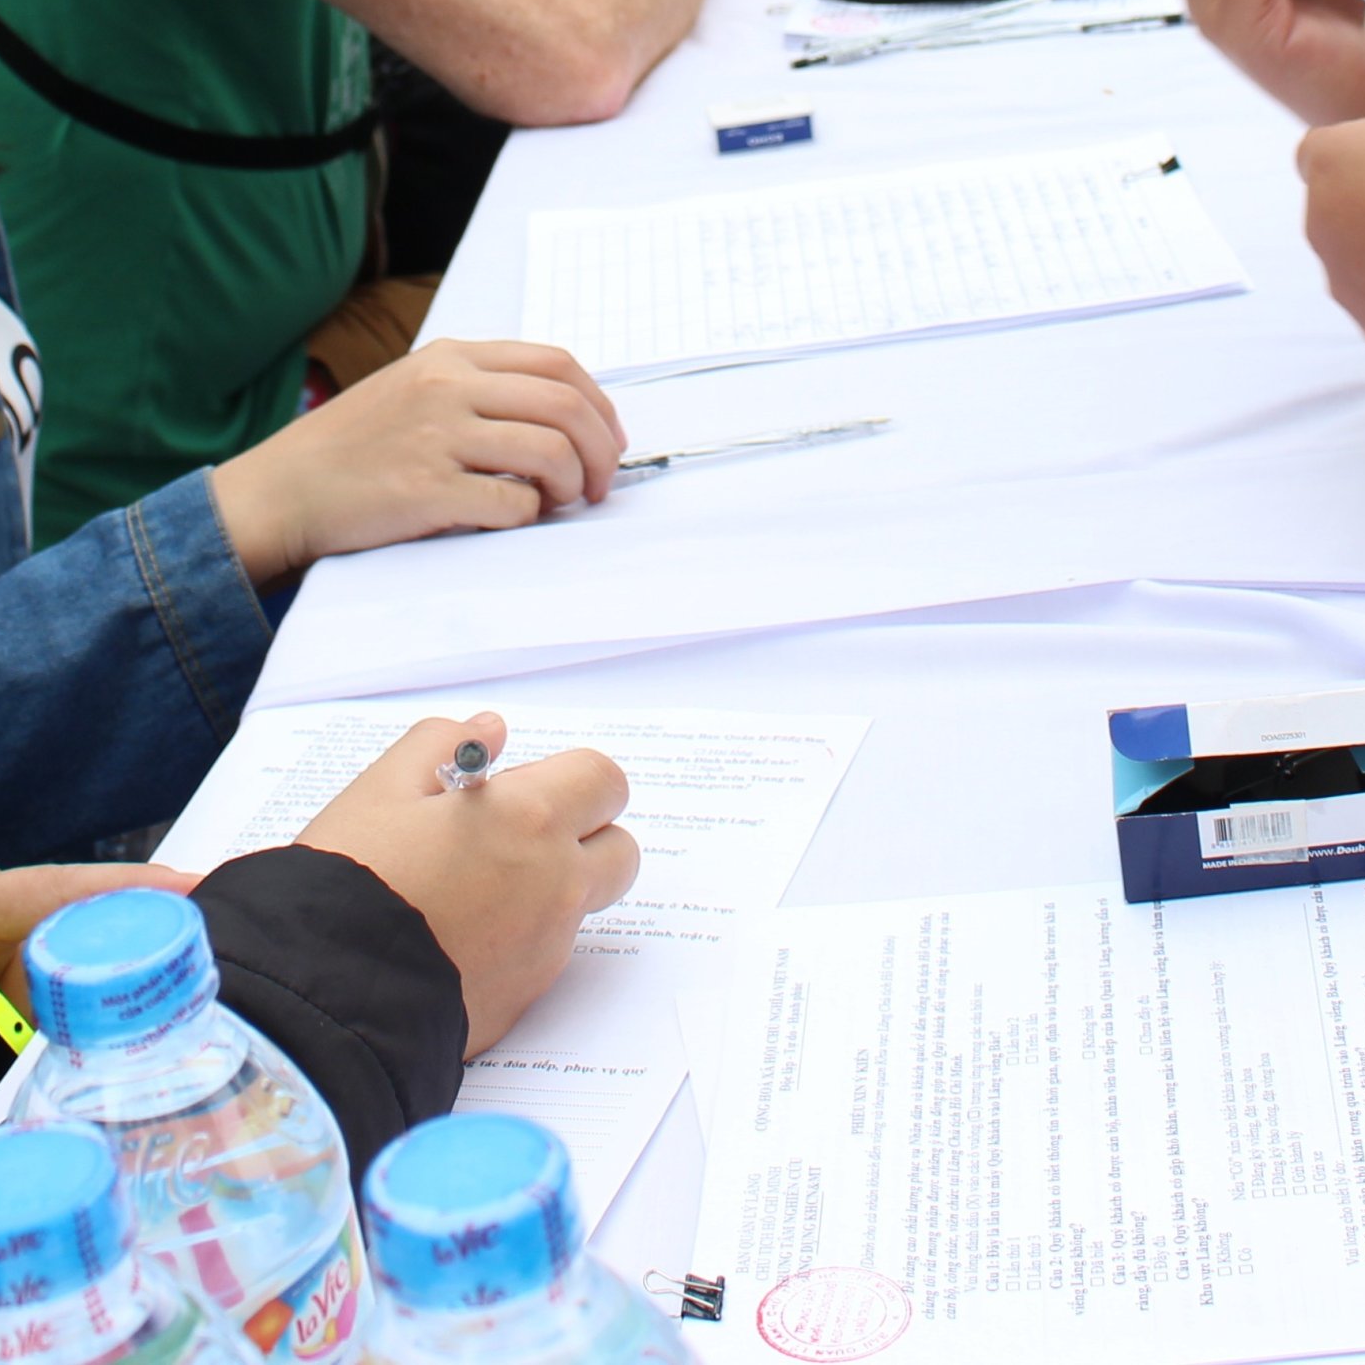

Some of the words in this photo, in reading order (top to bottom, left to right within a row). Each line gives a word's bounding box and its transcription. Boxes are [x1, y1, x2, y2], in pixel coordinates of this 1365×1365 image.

[1203, 860, 1228, 869] MADE
[589, 946, 620, 955] Chưa
[563, 1063, 598, 1074] phục
[987, 1170, 1002, 1189] mấy
[987, 1191, 1000, 1208] thứ
[986, 1210, 1000, 1226] lần
[1048, 1198, 1061, 1229] khách
[1192, 1198, 1208, 1232] không?
[986, 1227, 1000, 1237] là
[1069, 1223, 1083, 1258] không?
[986, 1239, 999, 1258] Đây
[1048, 1232, 1064, 1253] Quý
[1196, 1234, 1211, 1260] Lăng
[986, 1260, 1000, 1269] 1:
[1049, 1256, 1062, 1266] 2:
[1049, 1268, 1063, 1290] Câu
[1071, 1260, 1086, 1286] Lăng
[1200, 1262, 1213, 1281] vực
[985, 1271, 999, 1293] Câu
[1071, 1288, 1087, 1315] viếng
[1199, 1283, 1214, 1306] Khu
